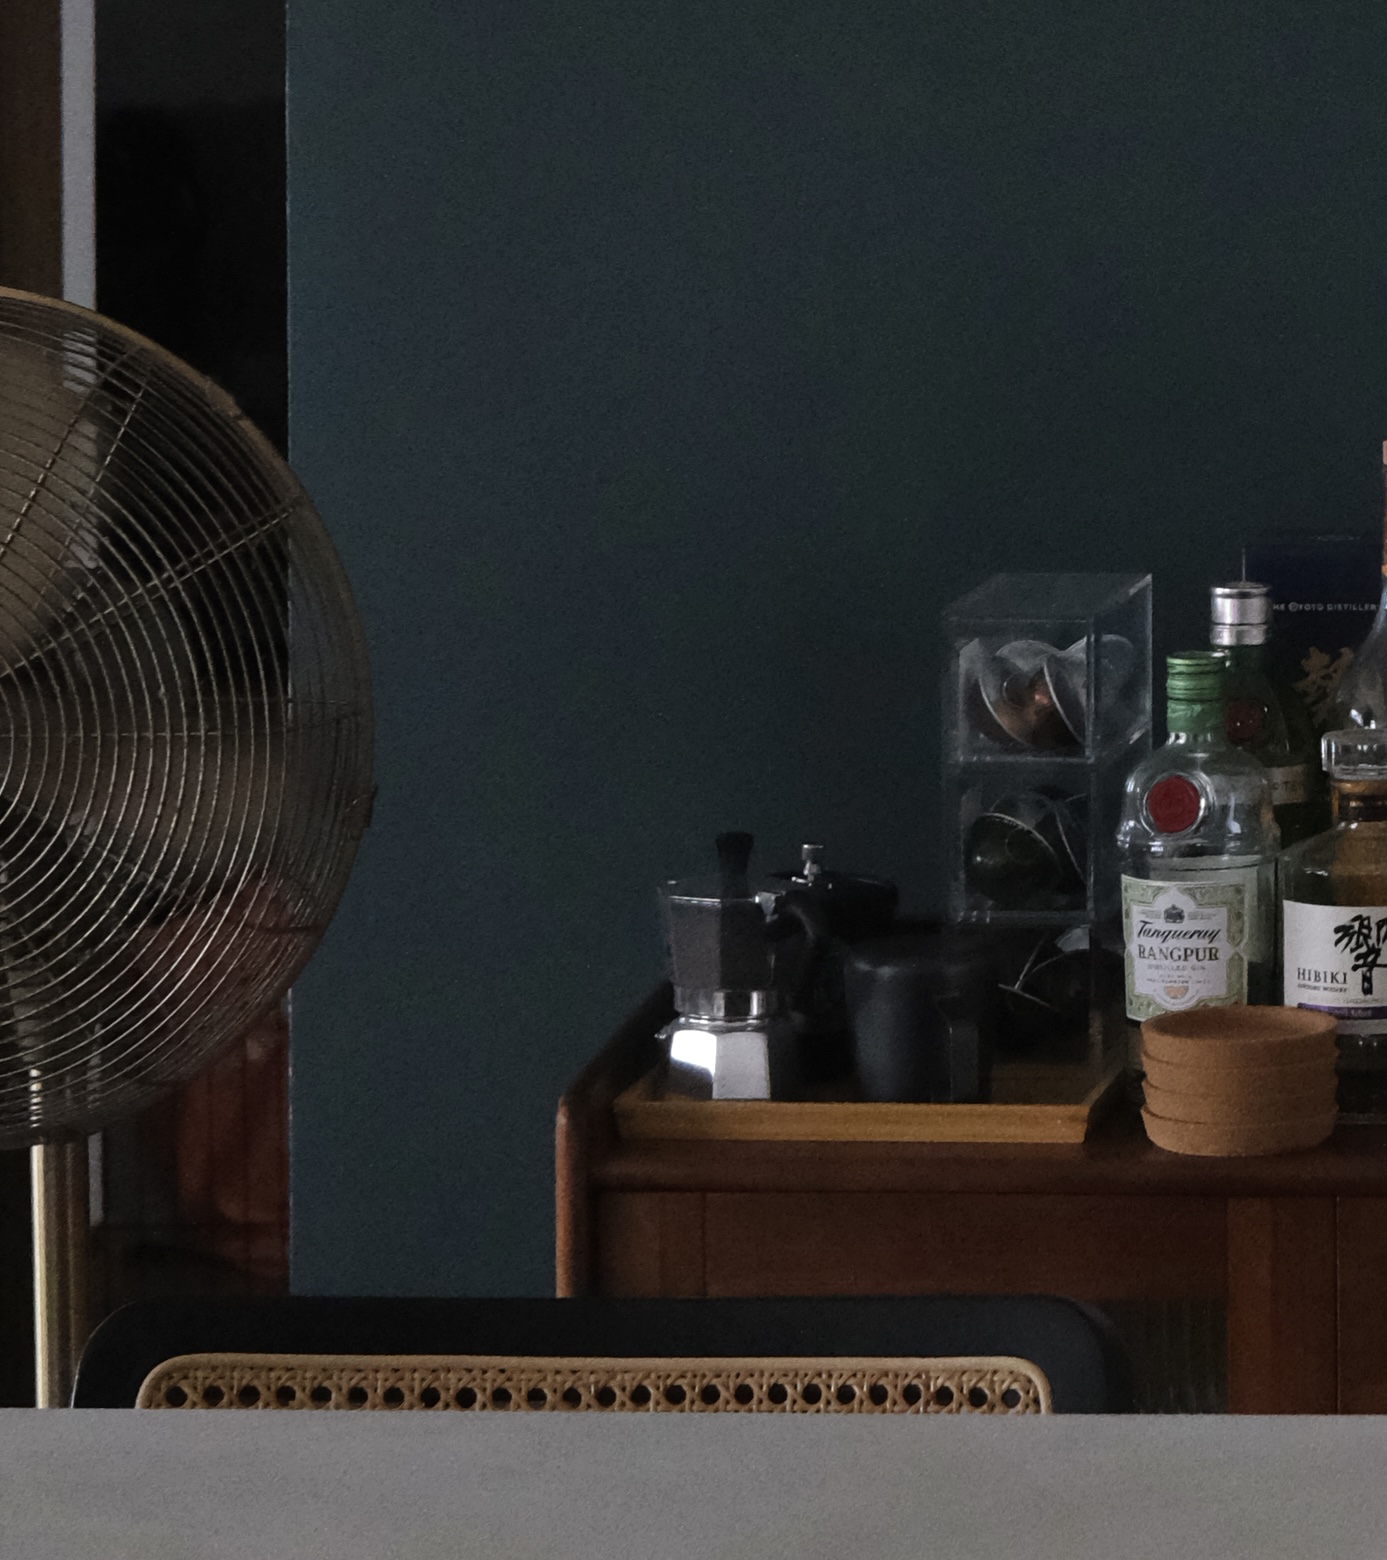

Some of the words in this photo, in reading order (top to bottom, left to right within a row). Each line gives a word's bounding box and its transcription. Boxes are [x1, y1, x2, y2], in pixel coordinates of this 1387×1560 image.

[1272, 603, 1286, 612] HE
[1326, 602, 1379, 612] DISTILLER
[1137, 920, 1222, 945] Tanqueray
[1138, 944, 1220, 962] RANGPUR
[1297, 966, 1349, 985] HIBIKI
